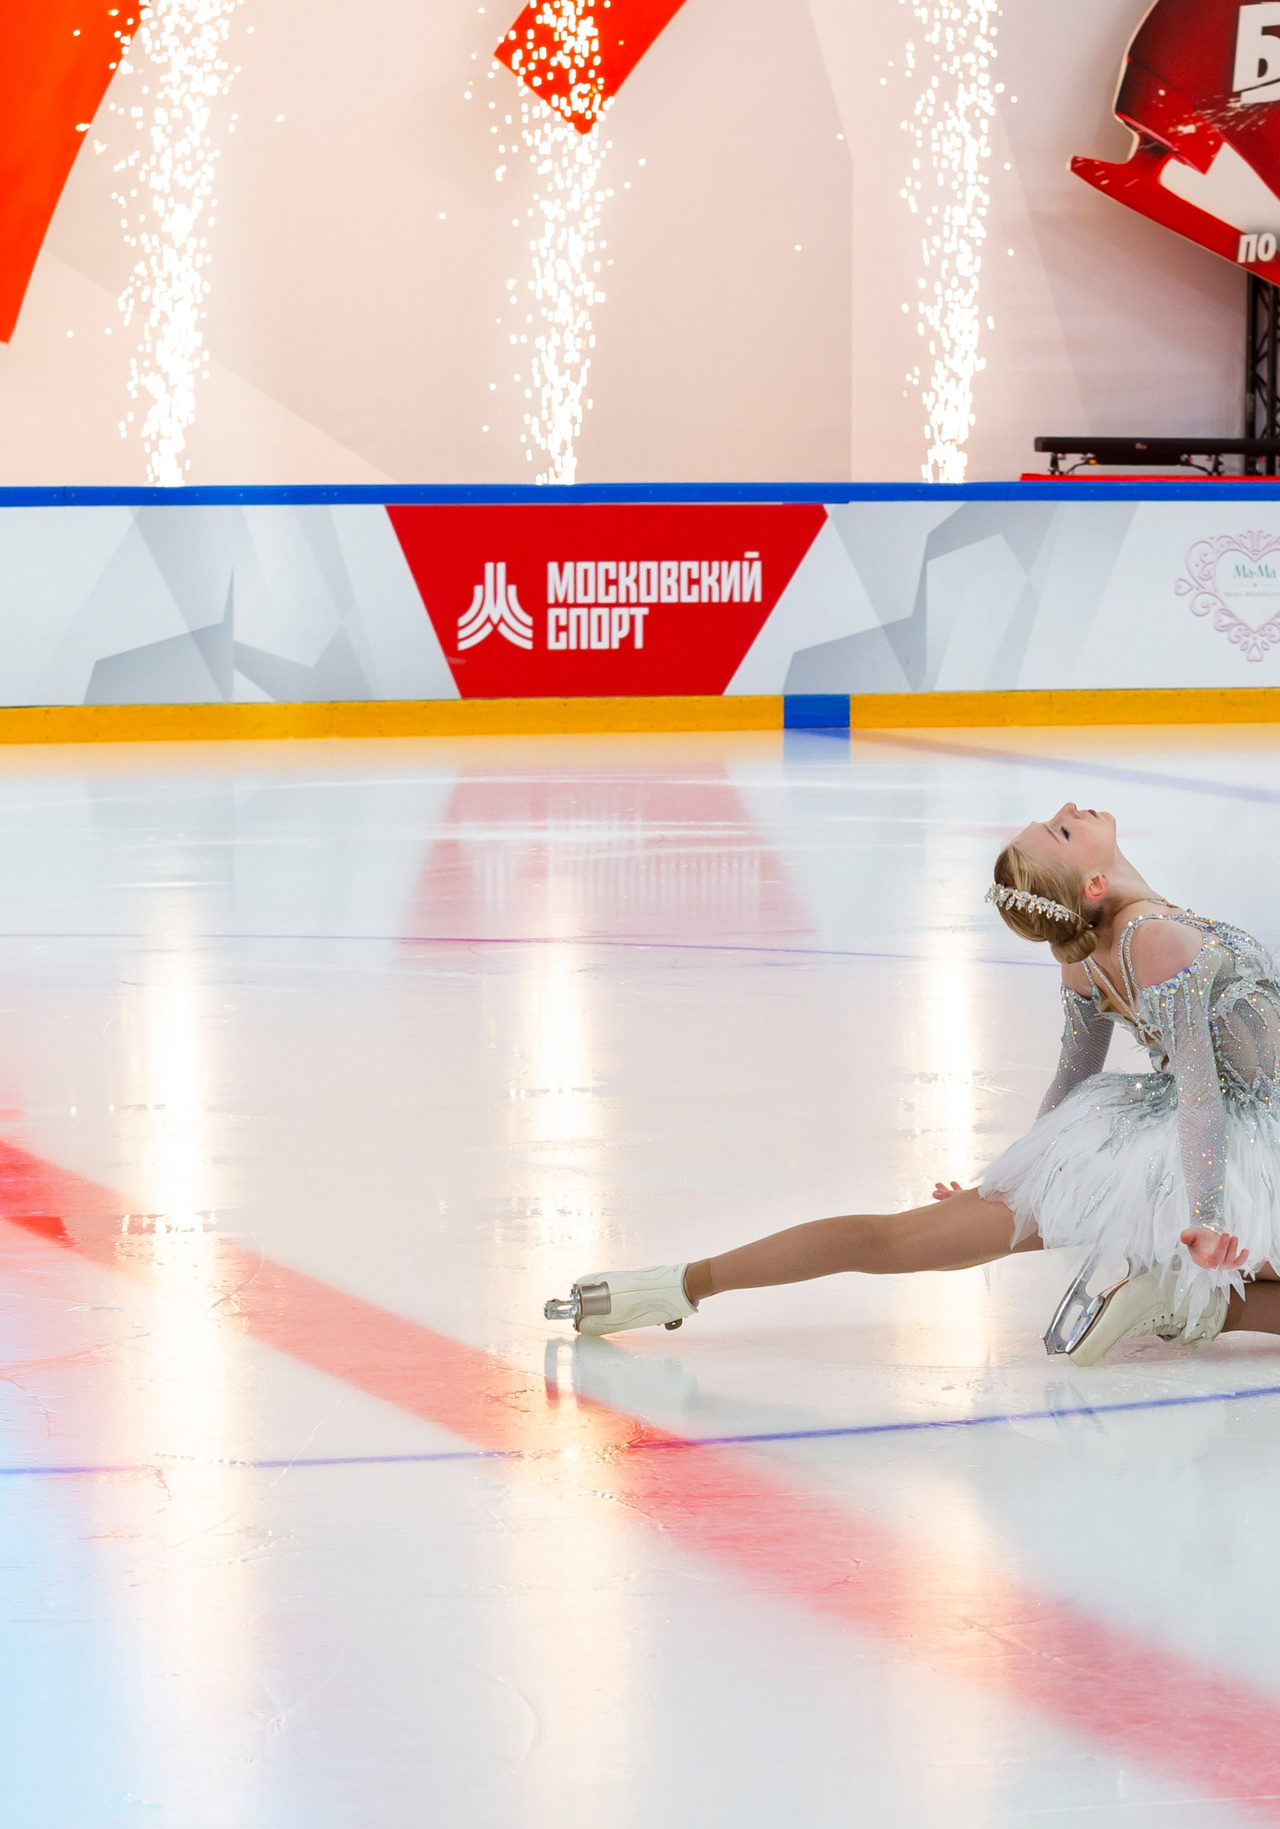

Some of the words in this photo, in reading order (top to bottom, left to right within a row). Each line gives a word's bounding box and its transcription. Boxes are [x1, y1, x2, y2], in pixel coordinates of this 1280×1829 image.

[1237, 233, 1277, 264] ПО
[546, 551, 763, 604] МОСКОВСКИЙ
[546, 607, 650, 650] СПОРТ
